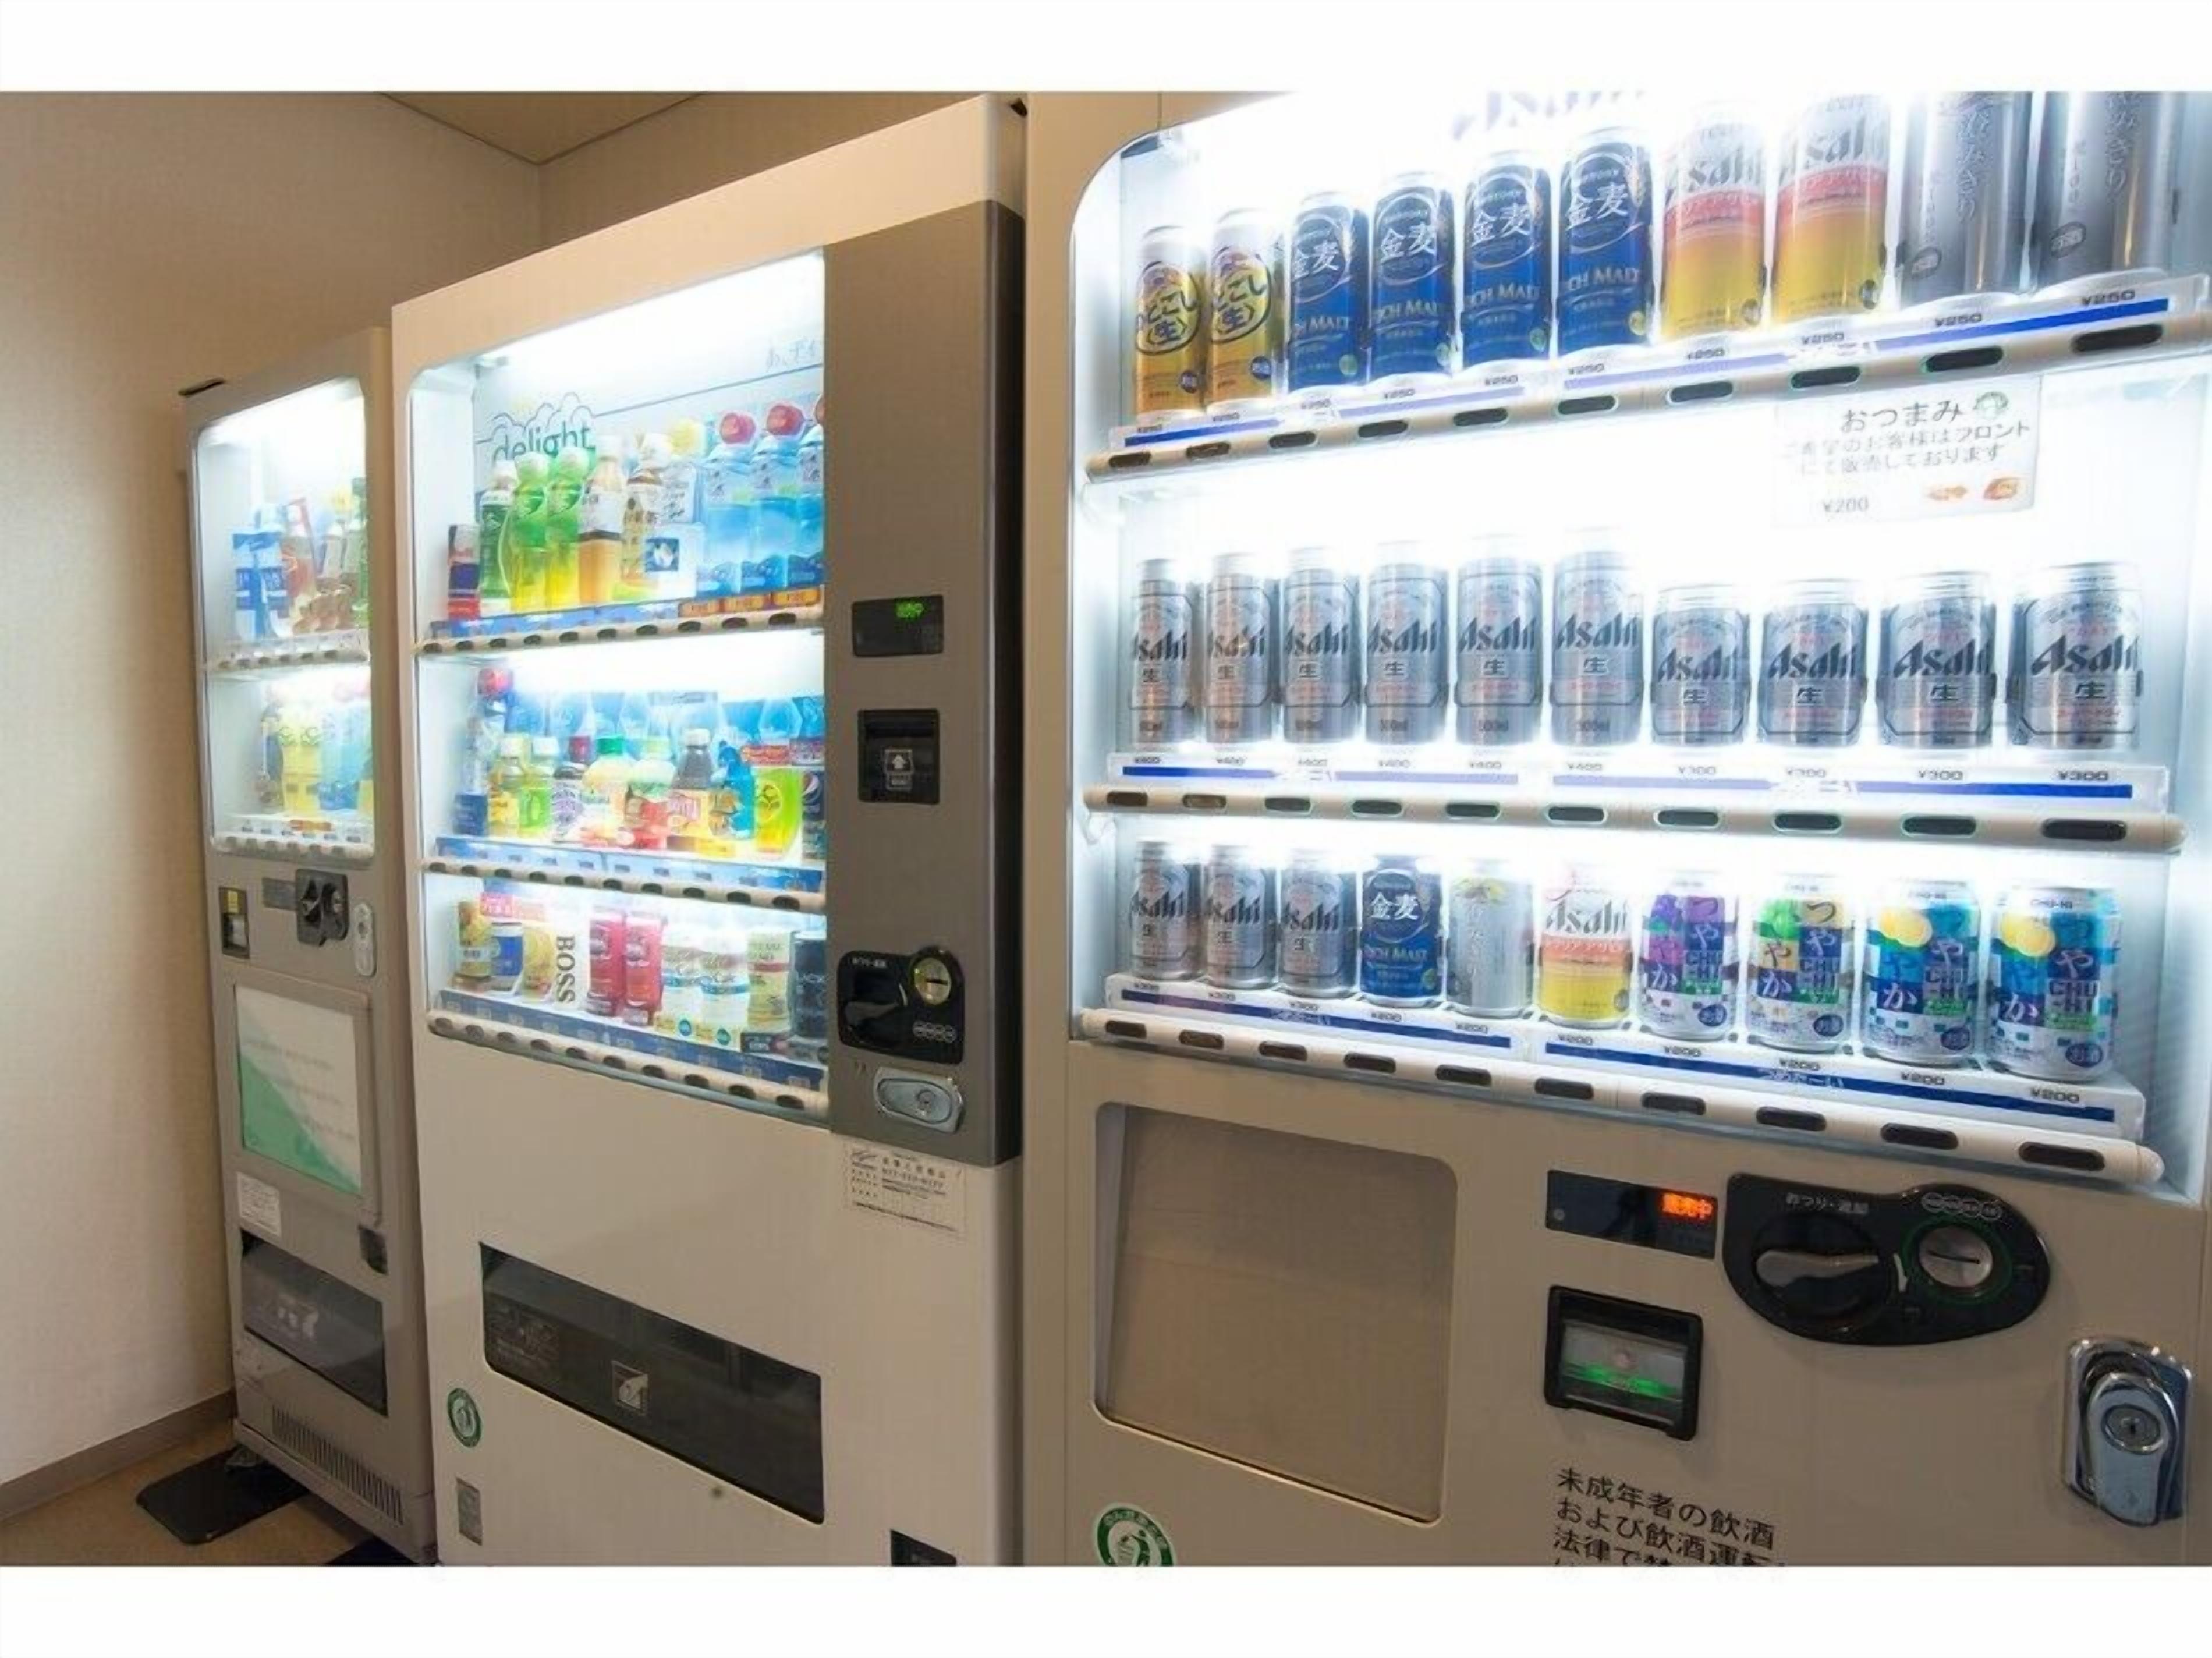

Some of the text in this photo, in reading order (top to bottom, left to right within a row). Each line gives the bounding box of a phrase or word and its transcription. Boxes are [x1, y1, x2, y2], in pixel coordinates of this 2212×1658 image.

[1471, 202, 1531, 247] 金麦
[1380, 221, 1437, 263] 金麦
[1934, 312, 1983, 327] ¥250
[2082, 289, 2136, 306] ¥250
[1841, 400, 1963, 434] おつまみ
[491, 420, 597, 465] delight
[1822, 497, 1869, 514] ¥200
[1367, 619, 1438, 653] Asahi
[1458, 617, 1536, 653] Asahi
[1554, 612, 1639, 649] Asahi
[1384, 661, 1407, 676] 生
[1483, 659, 1506, 675] 生
[1583, 657, 1608, 675] 生
[1657, 644, 1738, 682] Asahi
[1768, 642, 1859, 679] Asahi
[1892, 639, 1993, 678] Asahi
[2030, 634, 2141, 676] Asahi
[1683, 688, 1707, 704] 生
[1796, 687, 1824, 705] 生
[1930, 685, 1958, 702] 生
[2074, 681, 2106, 700] 生
[1917, 768, 1963, 781] ¥300
[2058, 769, 2109, 782] ¥300
[1369, 890, 1420, 921] 金麦
[1545, 900, 1628, 933] Asahi
[556, 935, 576, 1004] BOSS
[1900, 1071, 1945, 1086] ¥200
[2030, 1087, 2080, 1104] ¥200
[1557, 1467, 1774, 1551] 未成年者の飲酒
